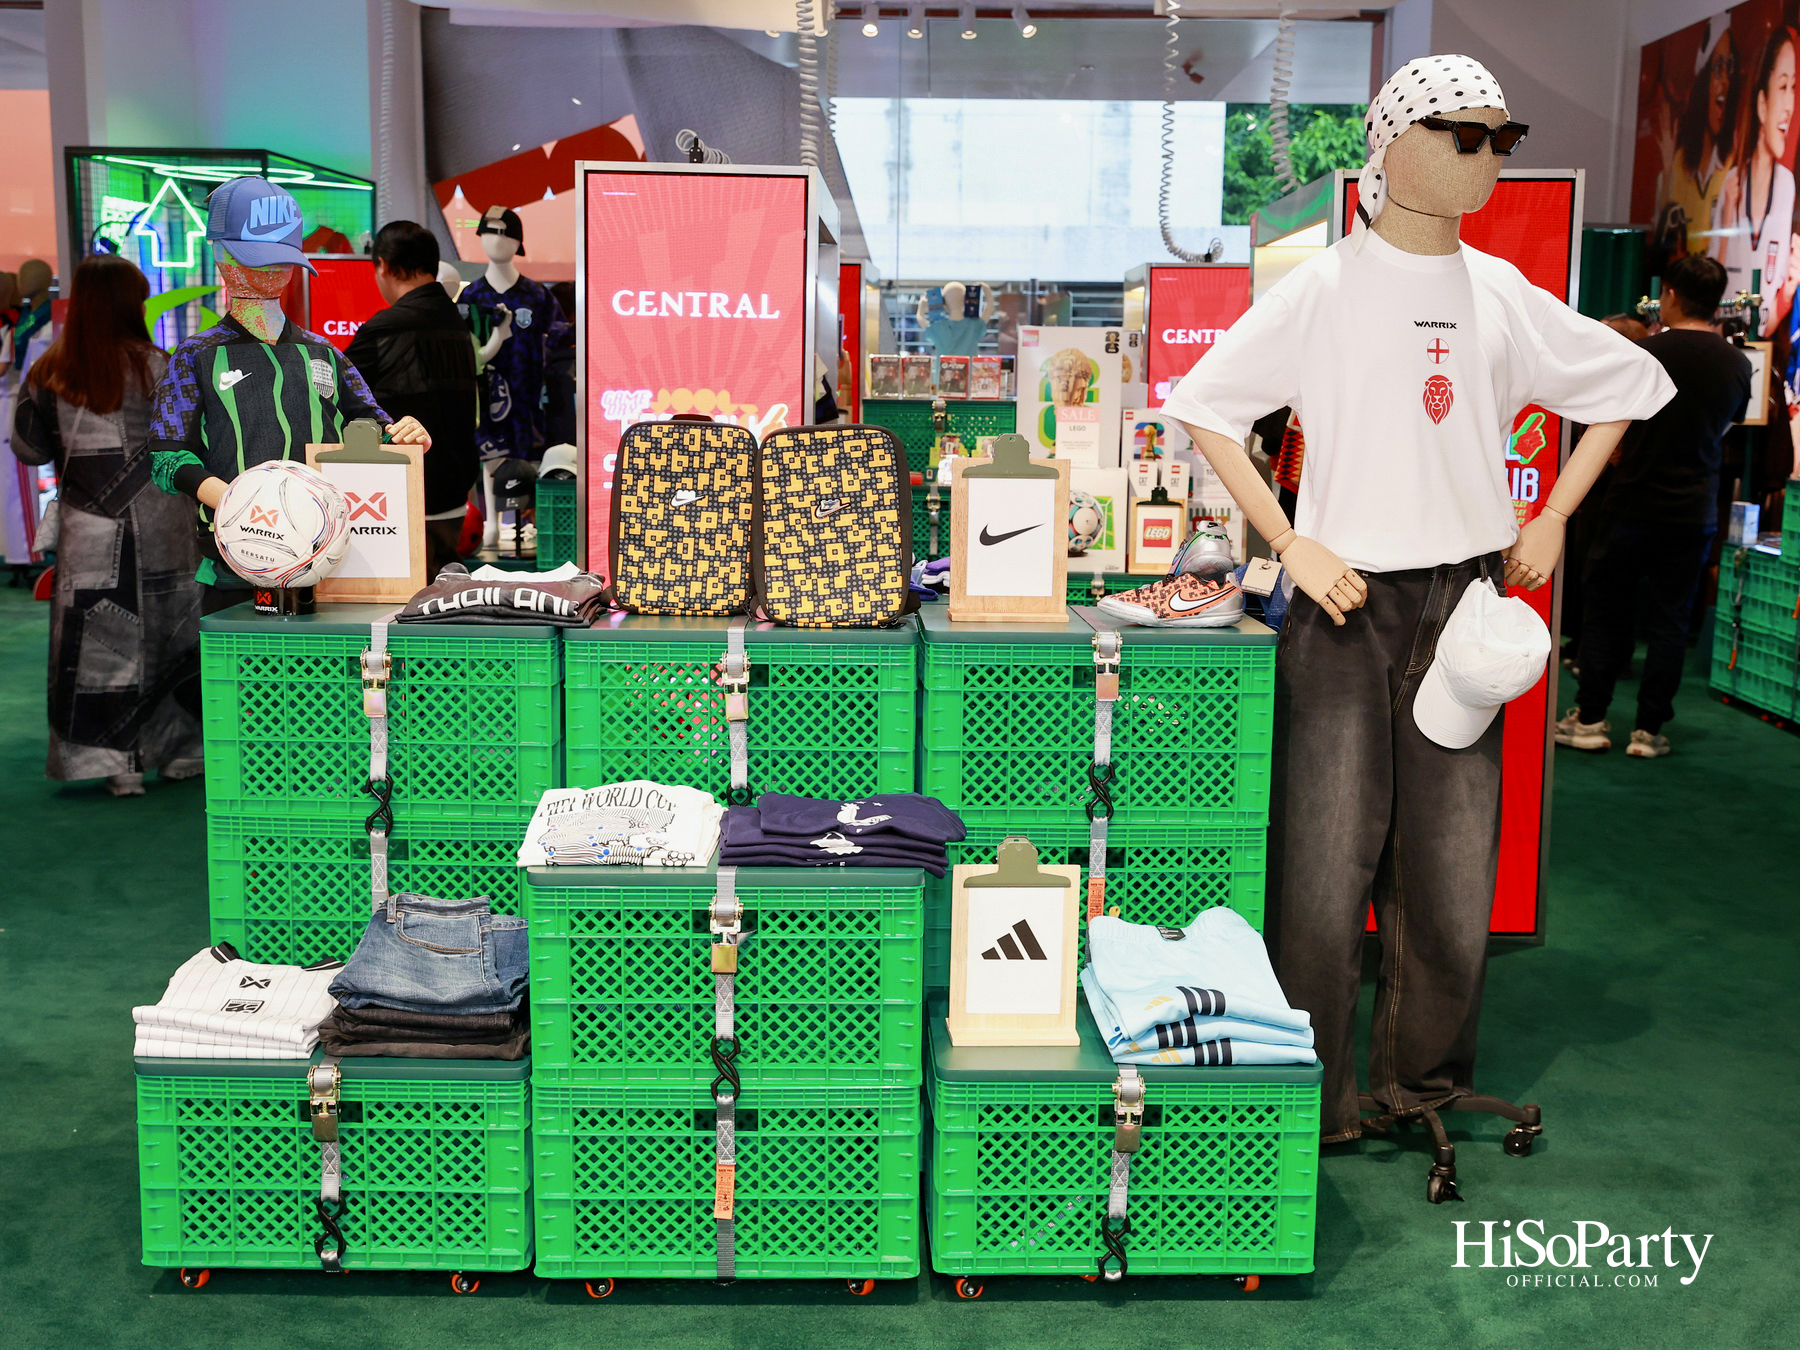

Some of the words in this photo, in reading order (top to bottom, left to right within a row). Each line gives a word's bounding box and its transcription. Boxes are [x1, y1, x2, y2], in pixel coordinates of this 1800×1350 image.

[250, 195, 298, 229] NIKE
[611, 290, 780, 319] CENTRAL
[1414, 320, 1457, 329] WARRIX
[1061, 407, 1095, 420] SALE
[240, 524, 285, 541] WARRIX
[350, 526, 398, 536] ARRIX
[1145, 527, 1171, 540] LEGO
[240, 549, 275, 562] BERSATU
[582, 786, 643, 810] WORLD
